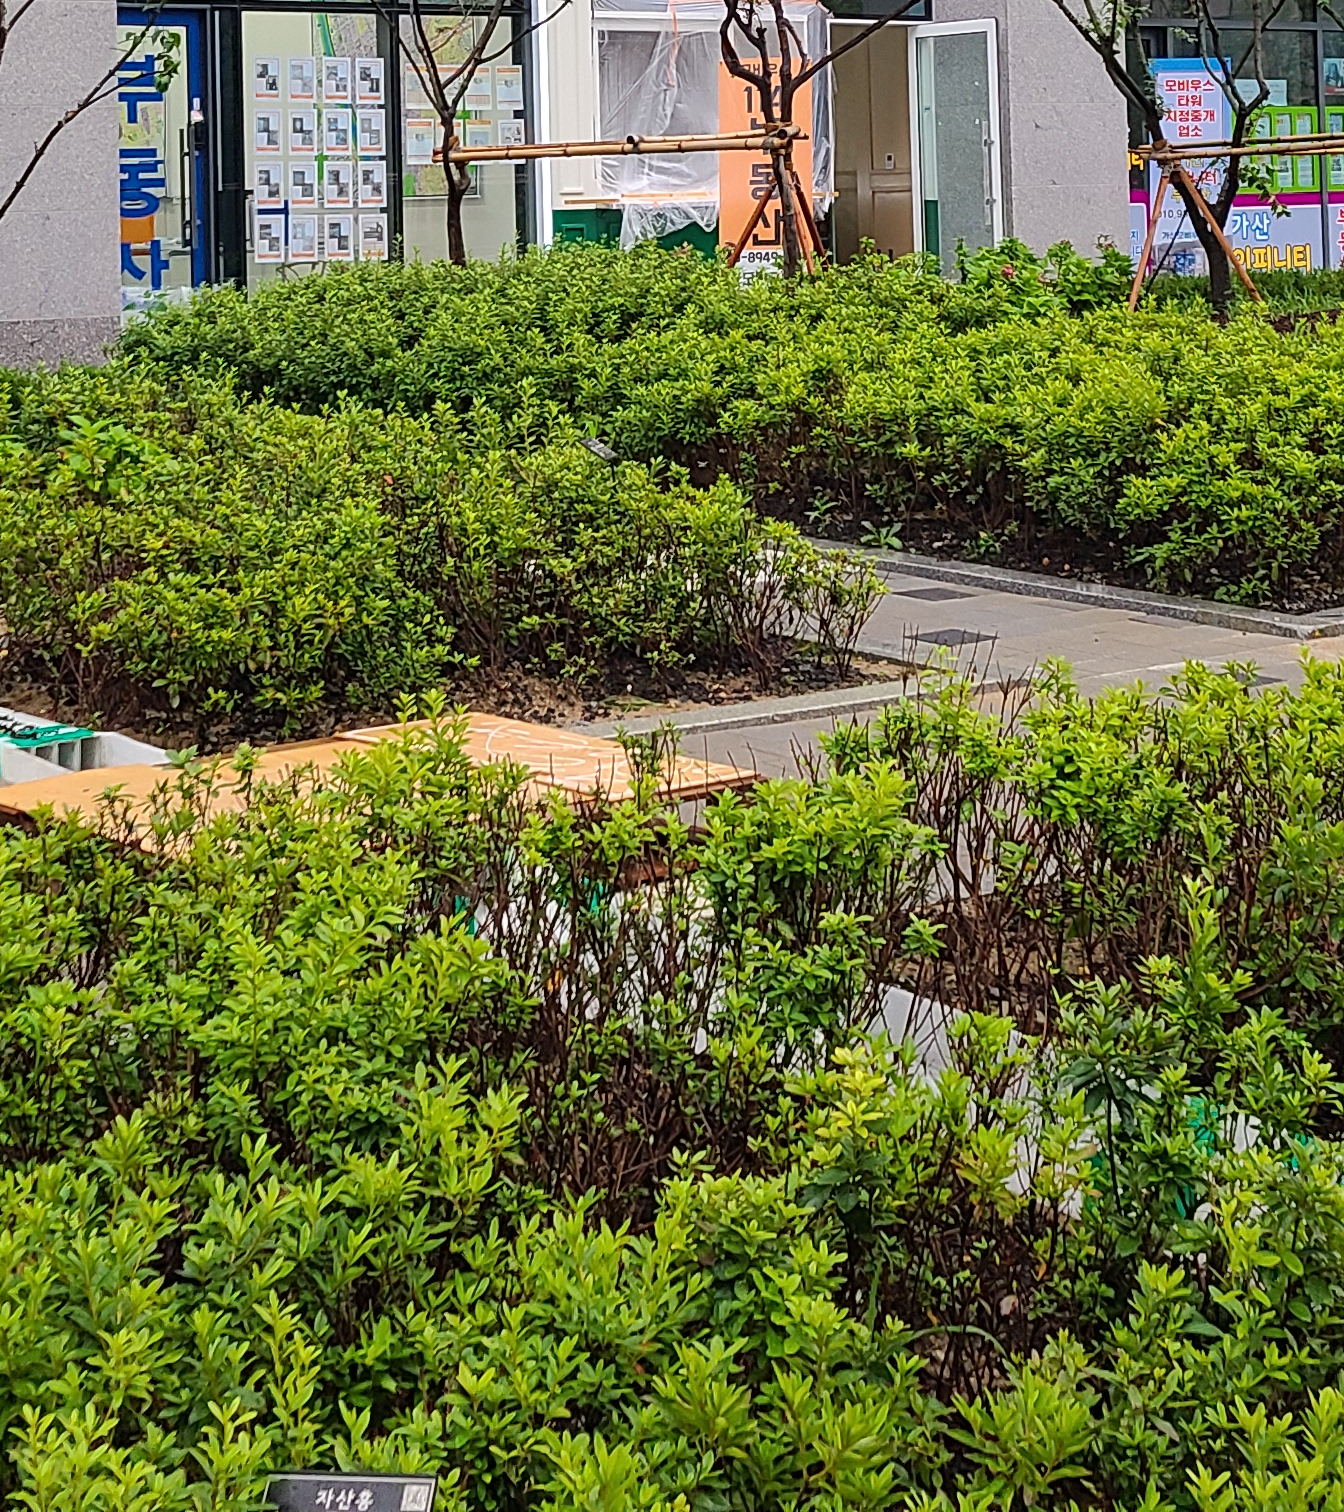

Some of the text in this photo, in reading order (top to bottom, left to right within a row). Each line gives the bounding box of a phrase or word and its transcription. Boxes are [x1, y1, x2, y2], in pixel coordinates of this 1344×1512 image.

[1164, 79, 1215, 93] 모비우스
[1177, 94, 1203, 108] 타워
[1178, 125, 1203, 138] 업소
[1231, 211, 1271, 241] 가산
